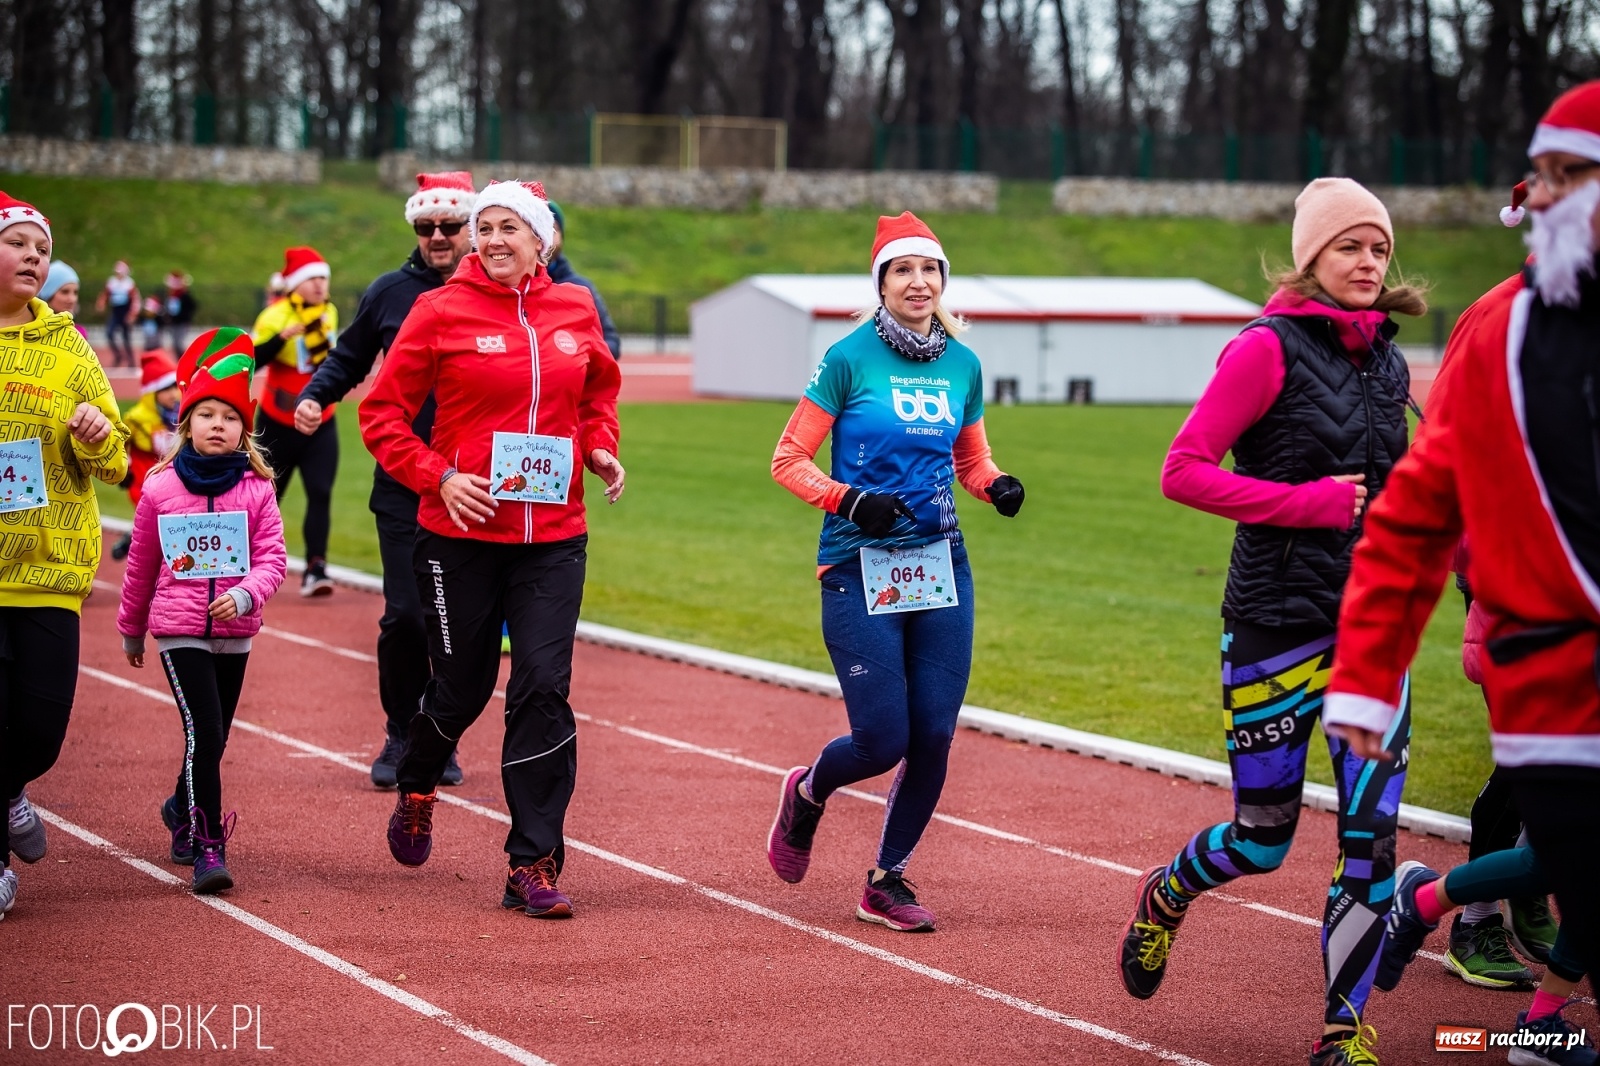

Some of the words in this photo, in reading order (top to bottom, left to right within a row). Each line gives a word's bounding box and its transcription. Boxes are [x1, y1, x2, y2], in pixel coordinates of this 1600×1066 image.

[476, 335, 506, 349] bbl
[891, 388, 956, 426] bbl
[905, 426, 944, 437] RACIBÓRZ
[0, 465, 16, 483] 4
[521, 456, 552, 475] 048
[187, 535, 222, 553] 059
[890, 565, 926, 584] 064
[428, 559, 453, 655] smsraciborz.pl
